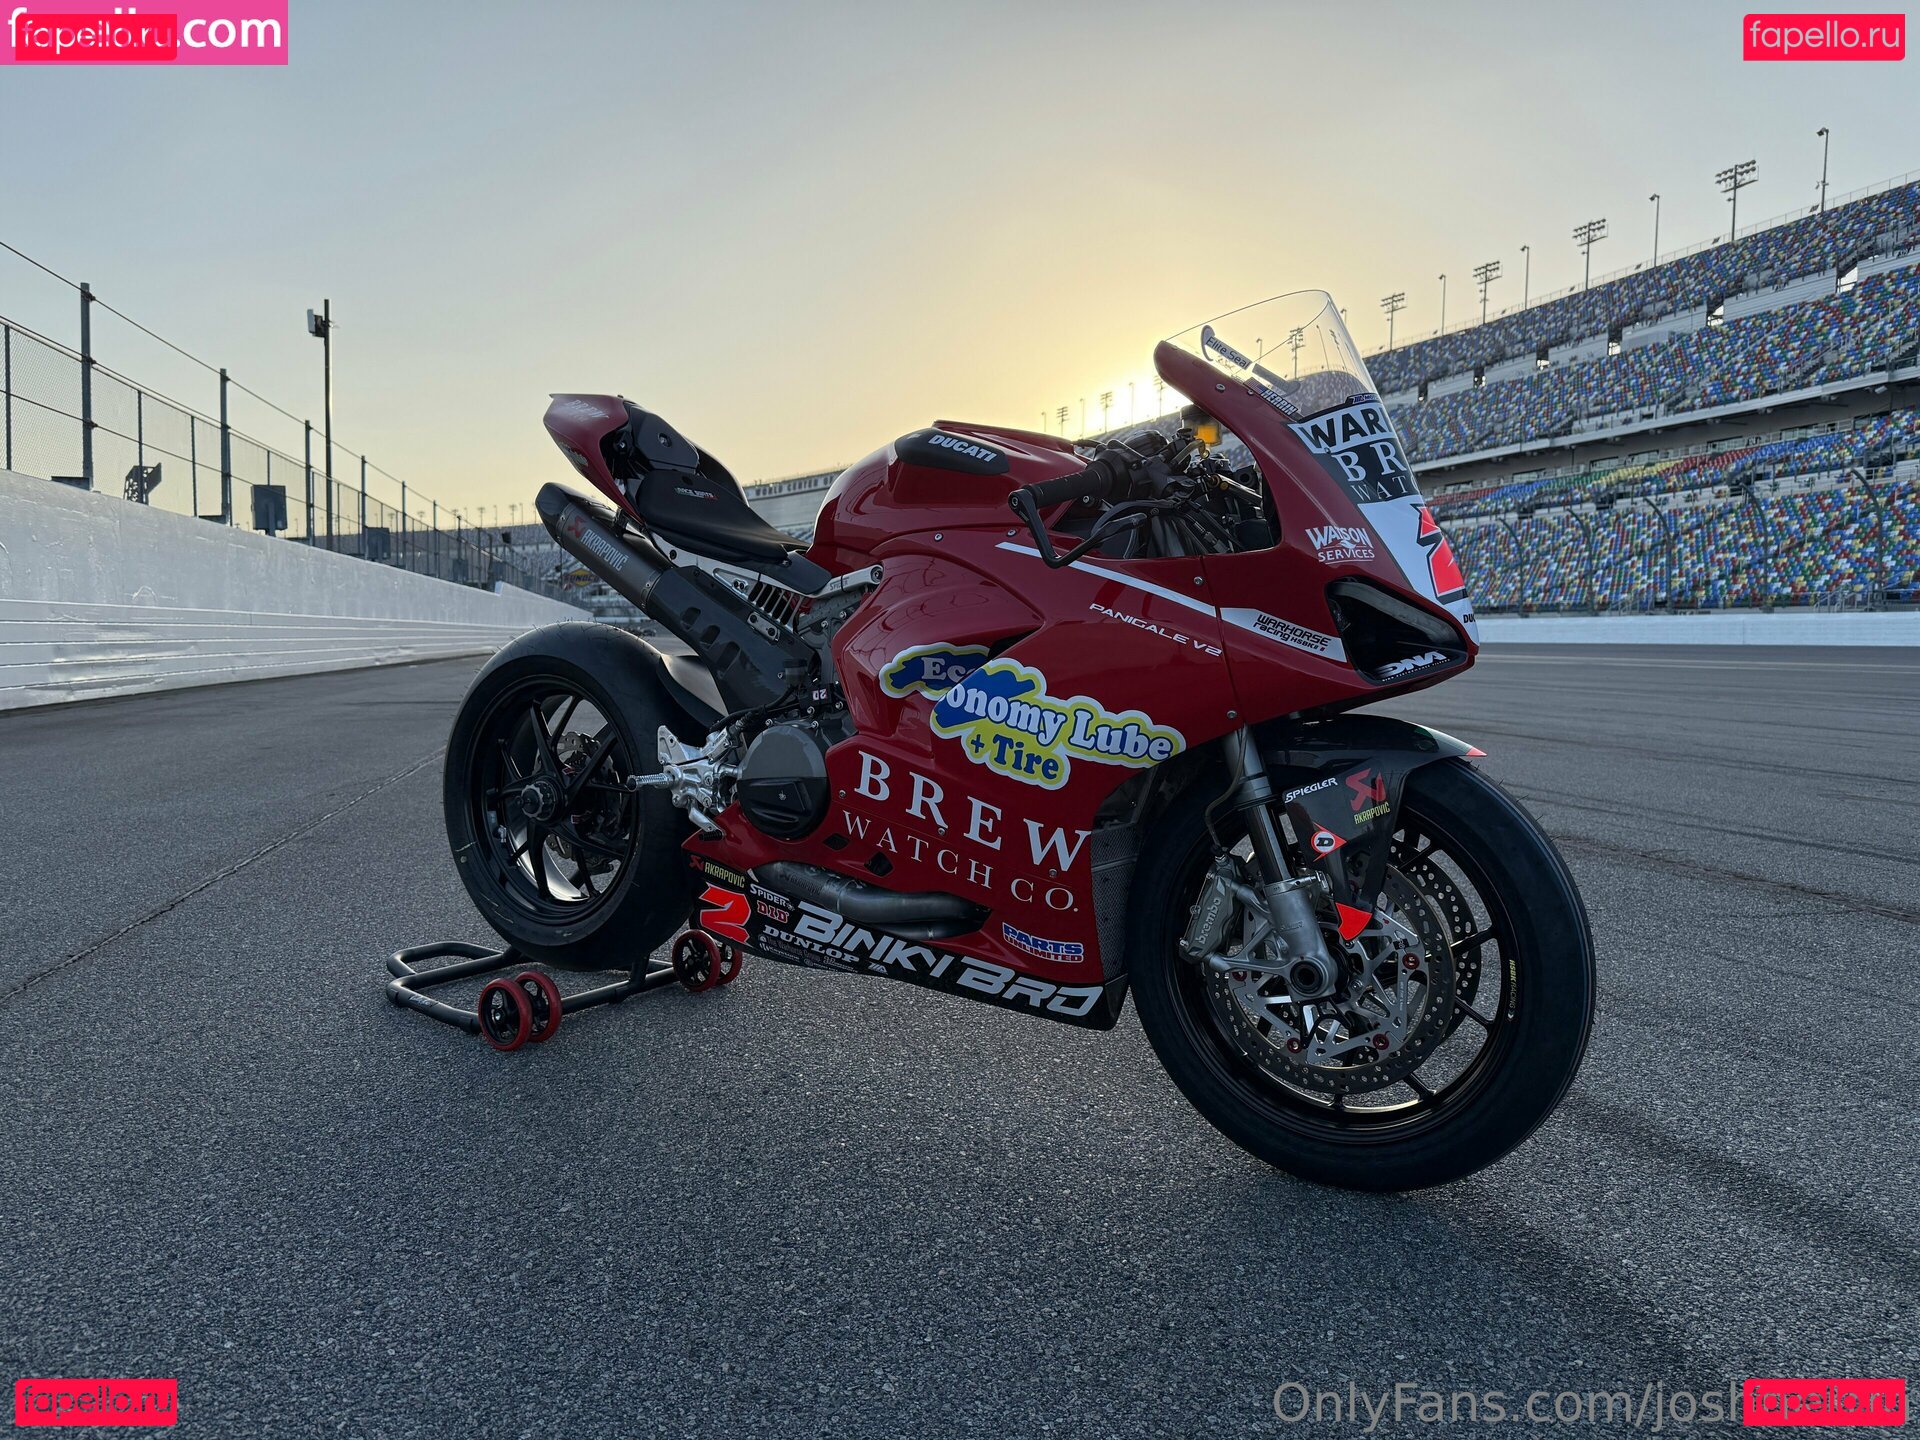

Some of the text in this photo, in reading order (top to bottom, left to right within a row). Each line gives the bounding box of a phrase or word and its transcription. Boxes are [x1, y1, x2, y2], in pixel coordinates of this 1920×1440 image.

[1206, 336, 1252, 370] Elite Seal
[928, 434, 997, 462] DUCATI
[1305, 525, 1374, 550] WATSON
[1318, 549, 1375, 562] SERVICES
[1089, 603, 1222, 657] PANIGALE V2
[1253, 622, 1290, 642] racing
[1257, 614, 1332, 647] WARHORSE
[1375, 651, 1447, 677] DNA
[1068, 709, 1174, 760] Lube
[993, 733, 1060, 779] Tire
[1284, 777, 1338, 804] SPIEGLER
[853, 750, 1092, 872] BREW
[842, 810, 994, 889] WATCH
[1010, 878, 1079, 913] CO.
[750, 884, 787, 907] SPIDER
[698, 881, 753, 946] 2
[1195, 897, 1221, 945] brembo
[763, 924, 860, 963] DUNLOP
[1002, 922, 1083, 955] PARTS
[1004, 933, 1083, 963] UNLIMITED
[956, 956, 1103, 1017] BRO
